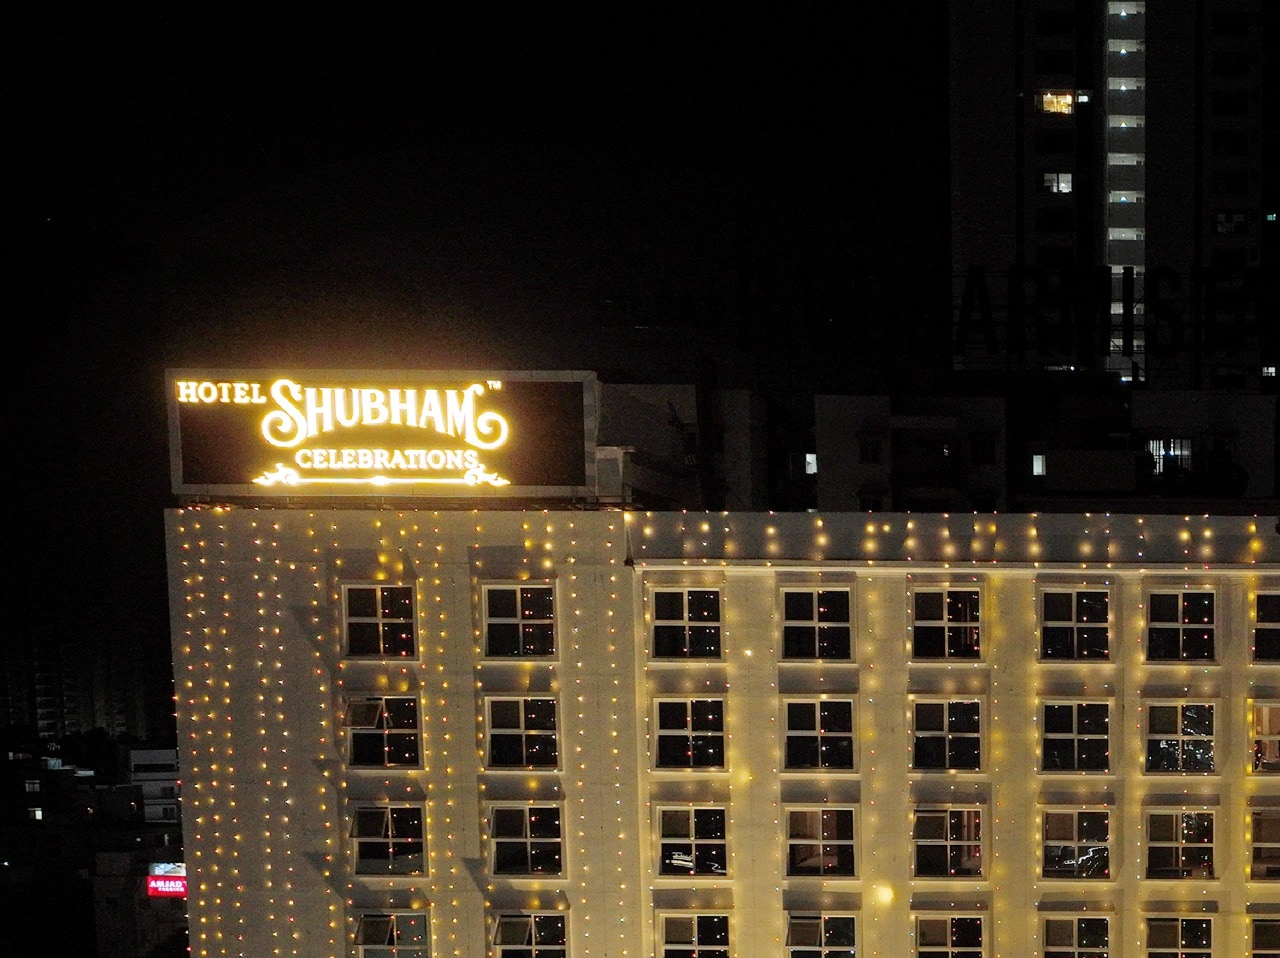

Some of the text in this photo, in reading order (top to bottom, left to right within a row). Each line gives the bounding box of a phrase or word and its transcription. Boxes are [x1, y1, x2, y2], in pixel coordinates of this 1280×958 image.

[177, 381, 267, 403] HOTEL
[261, 378, 508, 450] SHUBHAM
[295, 448, 478, 470] CELEBRATIONS
